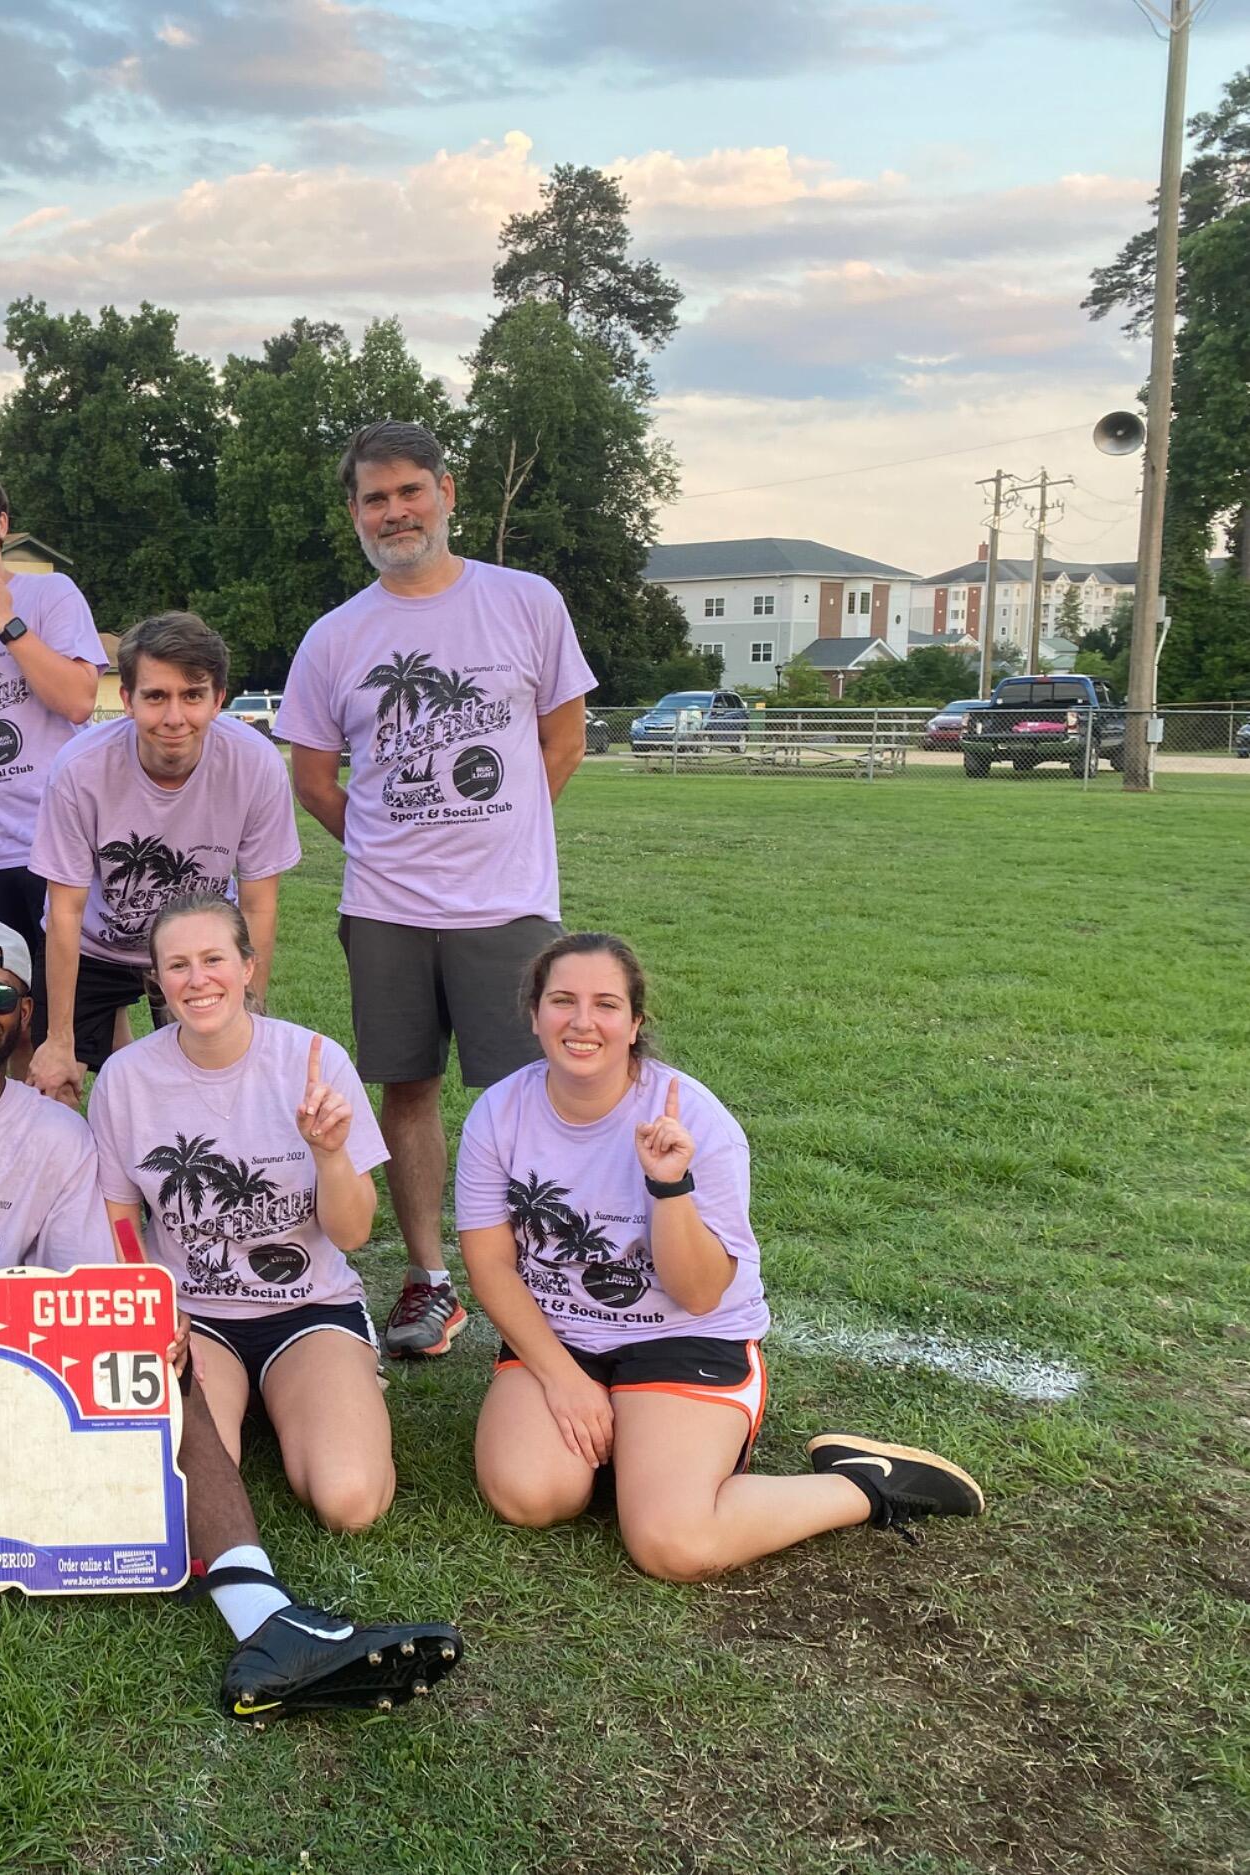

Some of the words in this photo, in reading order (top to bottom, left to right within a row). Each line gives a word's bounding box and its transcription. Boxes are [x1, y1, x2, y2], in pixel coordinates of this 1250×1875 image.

[462, 665, 495, 674] Summer
[8, 764, 34, 775] Club
[472, 771, 495, 780] LIGHT
[390, 811, 425, 823] Sport
[427, 809, 440, 818] &
[442, 806, 484, 818] Social
[486, 802, 513, 814] Club
[251, 1156, 284, 1165] Summer
[286, 1151, 306, 1161] 2021
[593, 1210, 631, 1223] Summer
[180, 1281, 221, 1296] Sport
[241, 1285, 287, 1299] Social
[33, 1289, 162, 1327] GUEST
[551, 1299, 565, 1312] &
[568, 1302, 618, 1323] Social
[623, 1311, 665, 1324] Club
[98, 1351, 162, 1406] 15
[58, 1558, 79, 1573] Order
[80, 1557, 102, 1572] online
[103, 1559, 112, 1572] at
[62, 1575, 155, 1587] www.BackyardScoreboards.com
